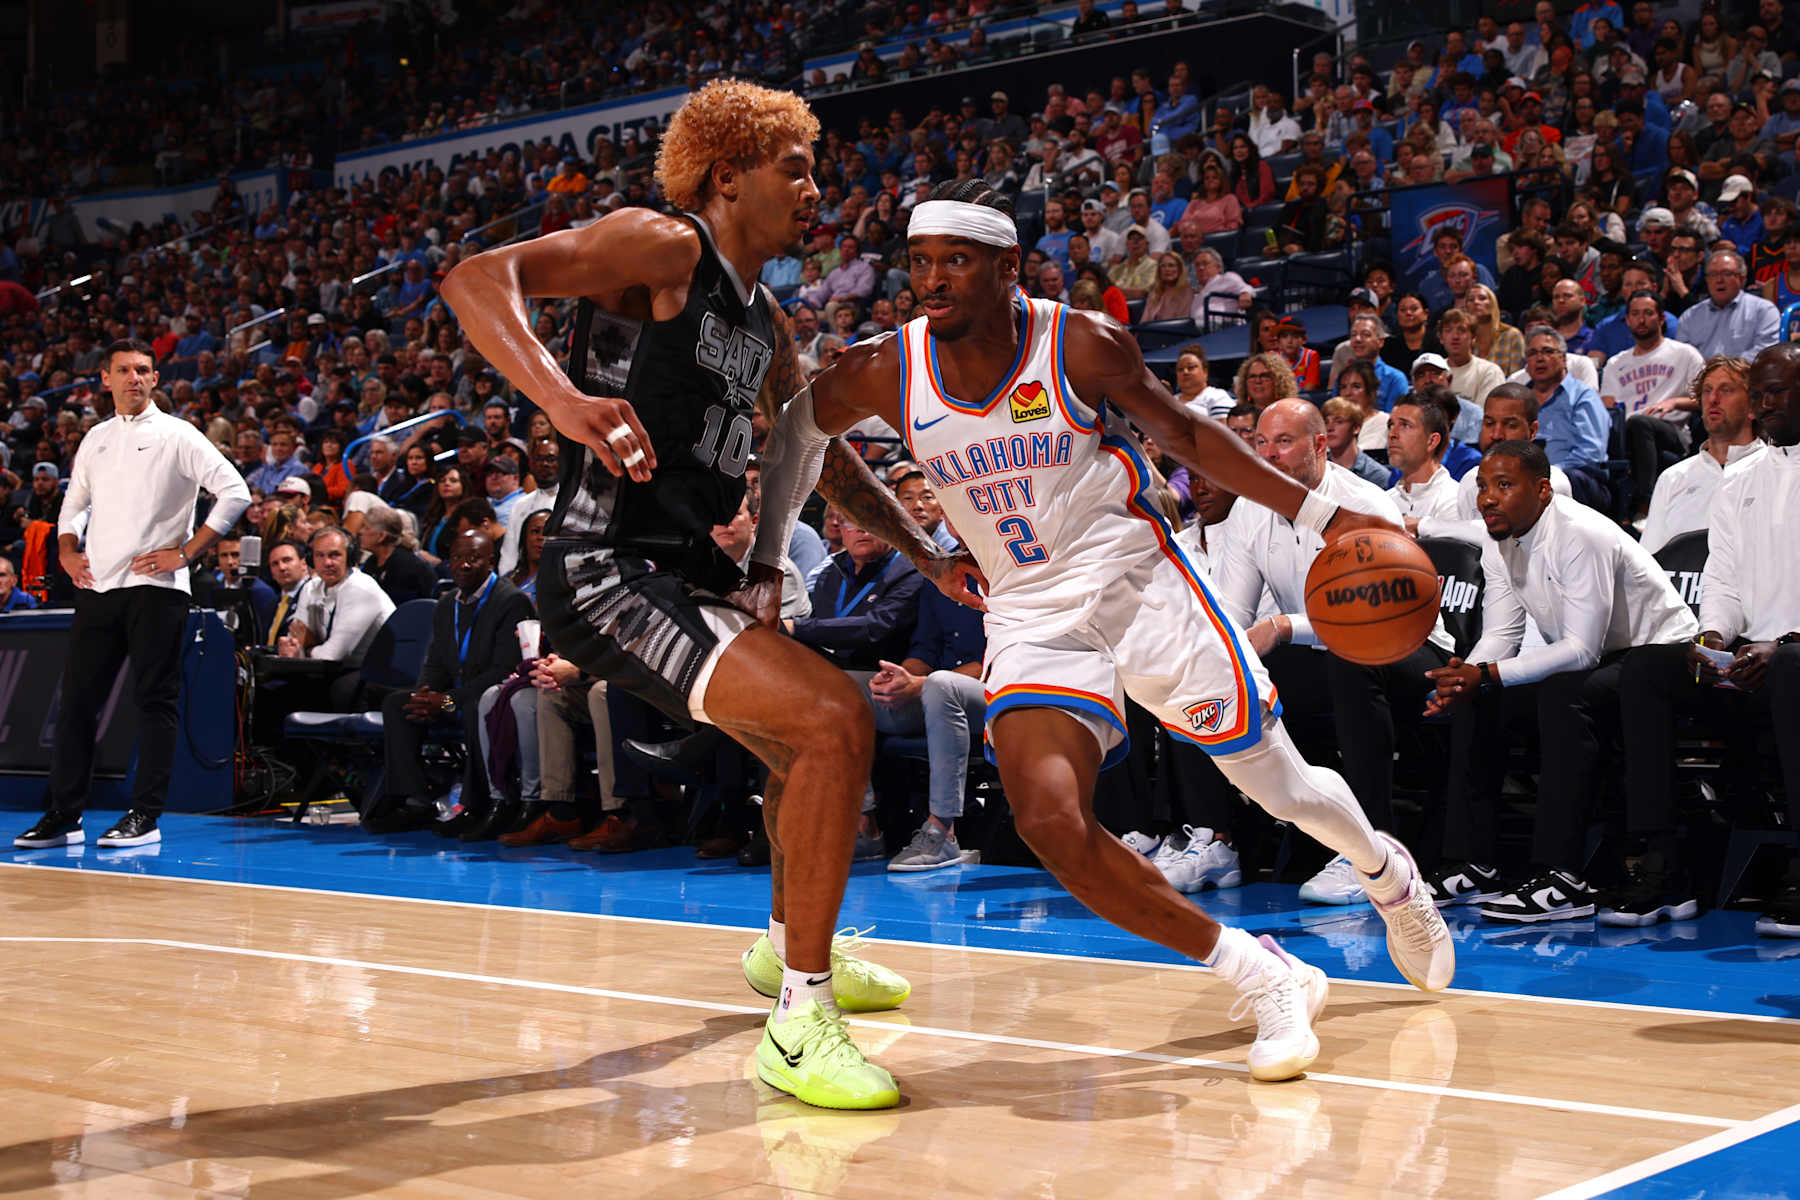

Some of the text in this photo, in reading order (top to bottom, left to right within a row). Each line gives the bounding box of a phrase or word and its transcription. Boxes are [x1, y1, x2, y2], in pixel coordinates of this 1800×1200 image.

[1618, 364, 1675, 387] OKLAHOMA
[1635, 378, 1658, 394] CITY
[692, 404, 753, 478] 10
[918, 431, 1074, 489] OKLAHOMA
[967, 476, 1036, 515] CITY
[996, 514, 1050, 567] 2
[1325, 576, 1419, 607] Wilson
[1440, 575, 1479, 613] App
[1191, 703, 1216, 728] OKC
